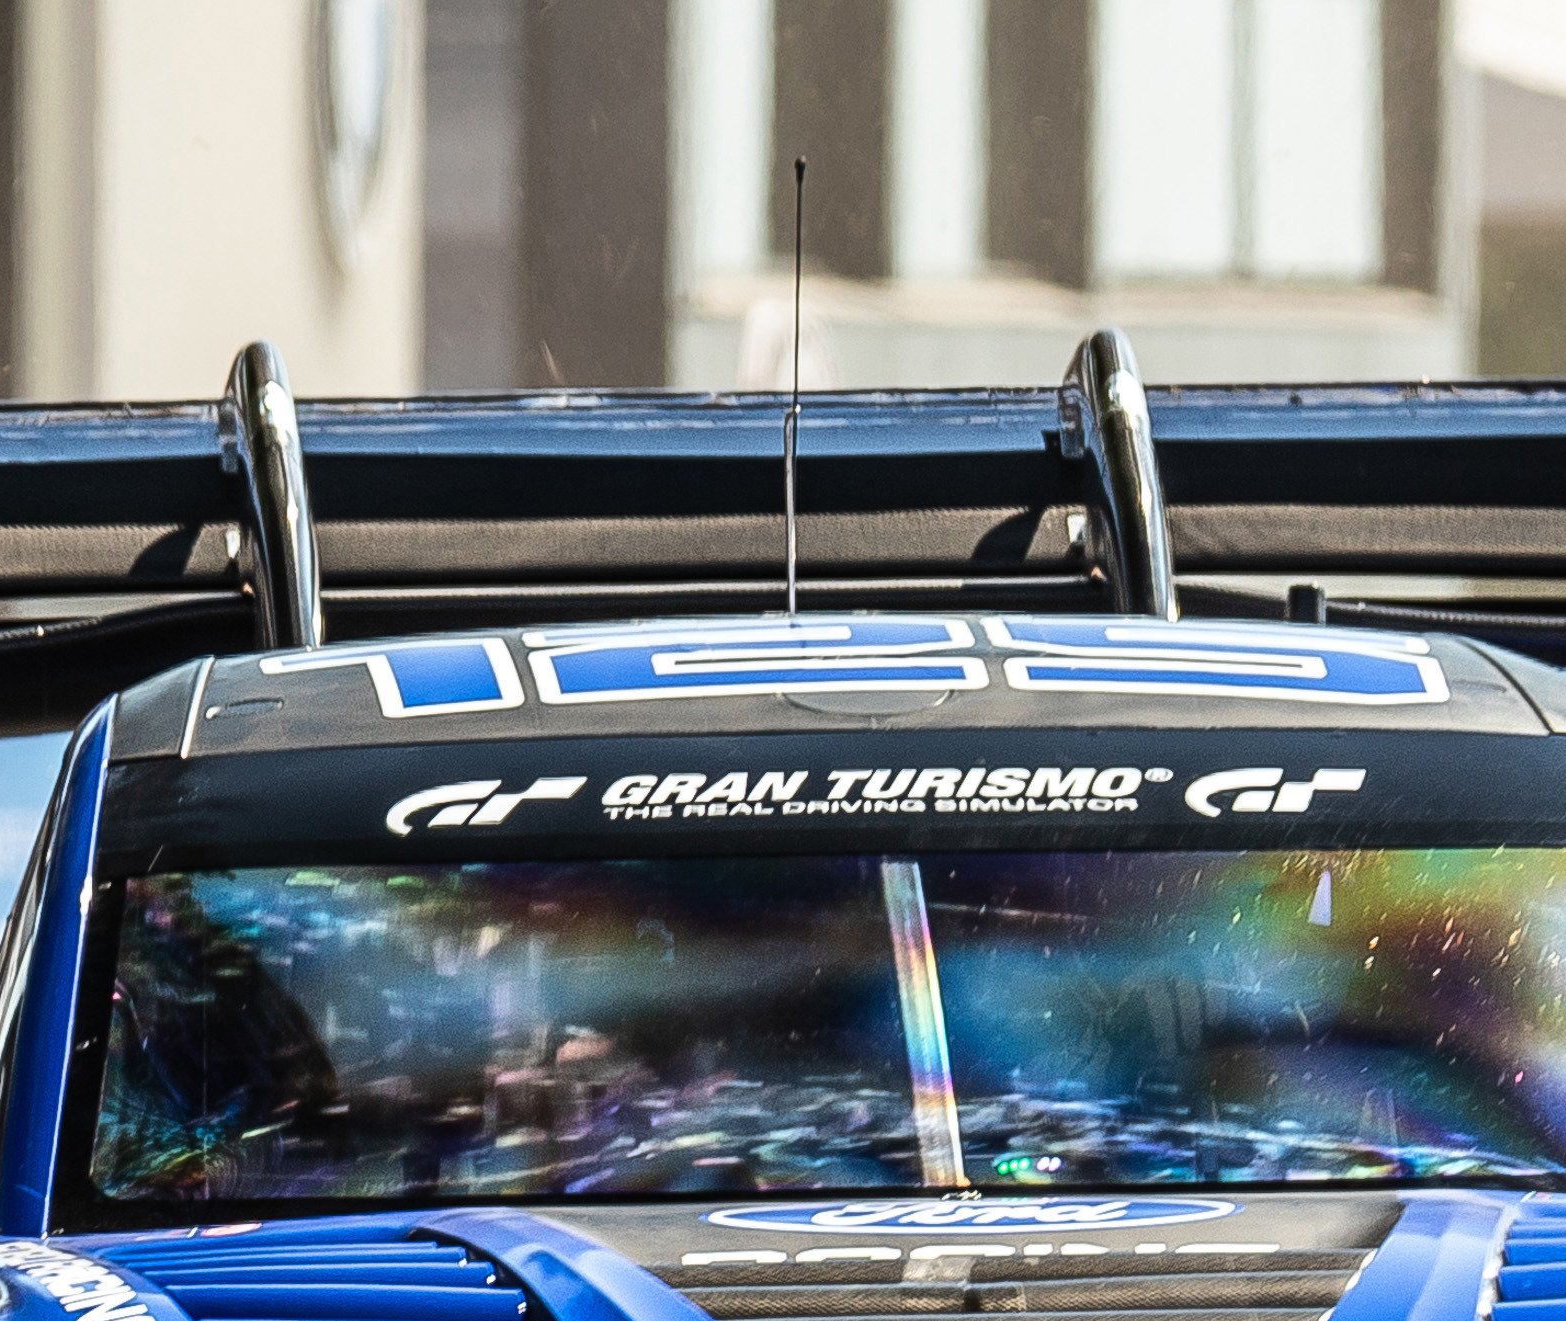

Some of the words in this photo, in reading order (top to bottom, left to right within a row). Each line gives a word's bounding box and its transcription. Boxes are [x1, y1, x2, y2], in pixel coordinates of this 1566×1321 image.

[259, 611, 1451, 718] 125
[386, 776, 588, 837] GT
[601, 771, 809, 806] GRAN
[603, 805, 673, 821] THE
[682, 801, 774, 818] REAL
[782, 799, 926, 816] DRIVING
[934, 797, 1139, 813] SIMULATOR
[1185, 768, 1366, 818] GT
[810, 1200, 1133, 1227] Ford
